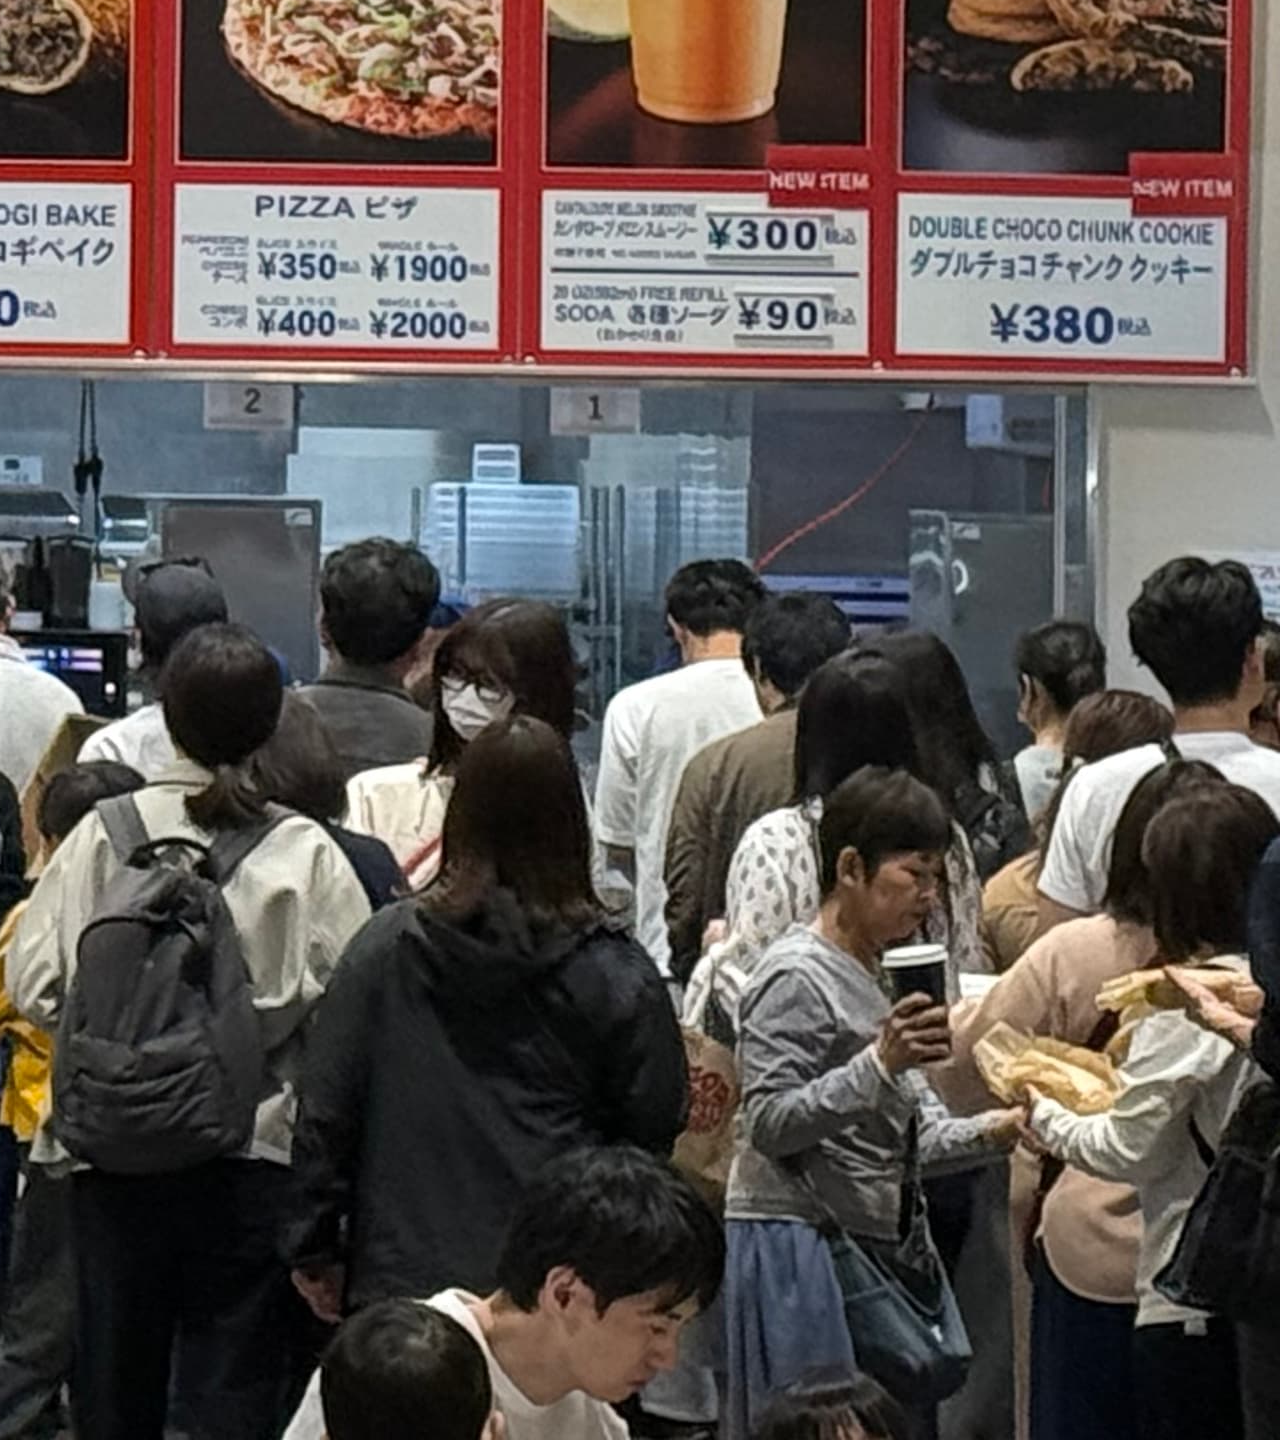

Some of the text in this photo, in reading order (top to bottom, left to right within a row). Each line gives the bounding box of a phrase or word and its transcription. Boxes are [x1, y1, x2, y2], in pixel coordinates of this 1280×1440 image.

[768, 171, 870, 191] NEW ITEM
[1132, 179, 1233, 198] NEW ITEM
[45, 204, 117, 228] BAKE
[255, 195, 418, 220] PIZZA ピザ
[908, 215, 1215, 246] DOUBLE CHOCO CHUNK COOKIE
[554, 304, 615, 323] SODA
[244, 388, 262, 414] 2
[588, 396, 603, 420] 1
